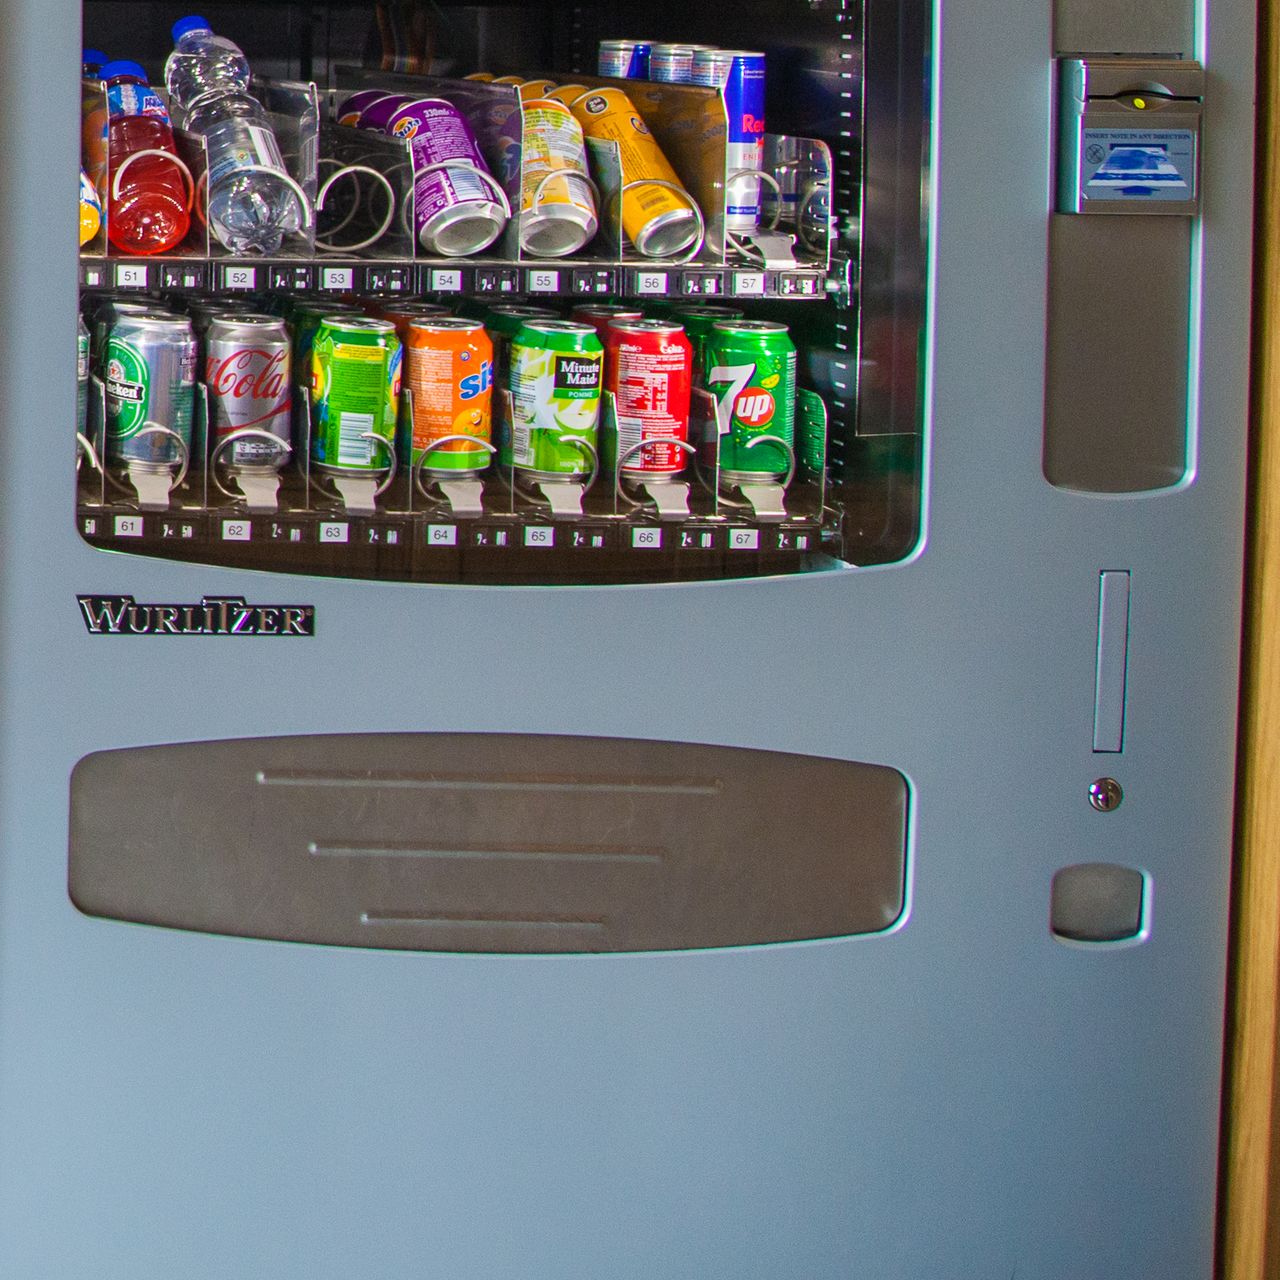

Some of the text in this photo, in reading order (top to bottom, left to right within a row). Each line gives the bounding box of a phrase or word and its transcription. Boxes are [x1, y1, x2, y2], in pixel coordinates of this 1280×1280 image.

[123, 271, 138, 281] 51
[232, 272, 248, 284] 52
[330, 273, 345, 284] 53
[438, 275, 453, 286] 54
[535, 275, 551, 287] 55
[644, 278, 659, 289] 56
[741, 278, 756, 289] 57
[560, 361, 600, 374] Minute
[214, 348, 289, 399] Cola
[566, 372, 597, 386] Maid
[708, 363, 756, 434] 7
[737, 394, 770, 422] up
[121, 521, 135, 532] 61
[228, 525, 243, 536] 62
[325, 527, 340, 538] 63
[433, 530, 448, 540] 64
[531, 531, 546, 542] 65
[638, 532, 654, 543] 66
[735, 534, 751, 544] 67
